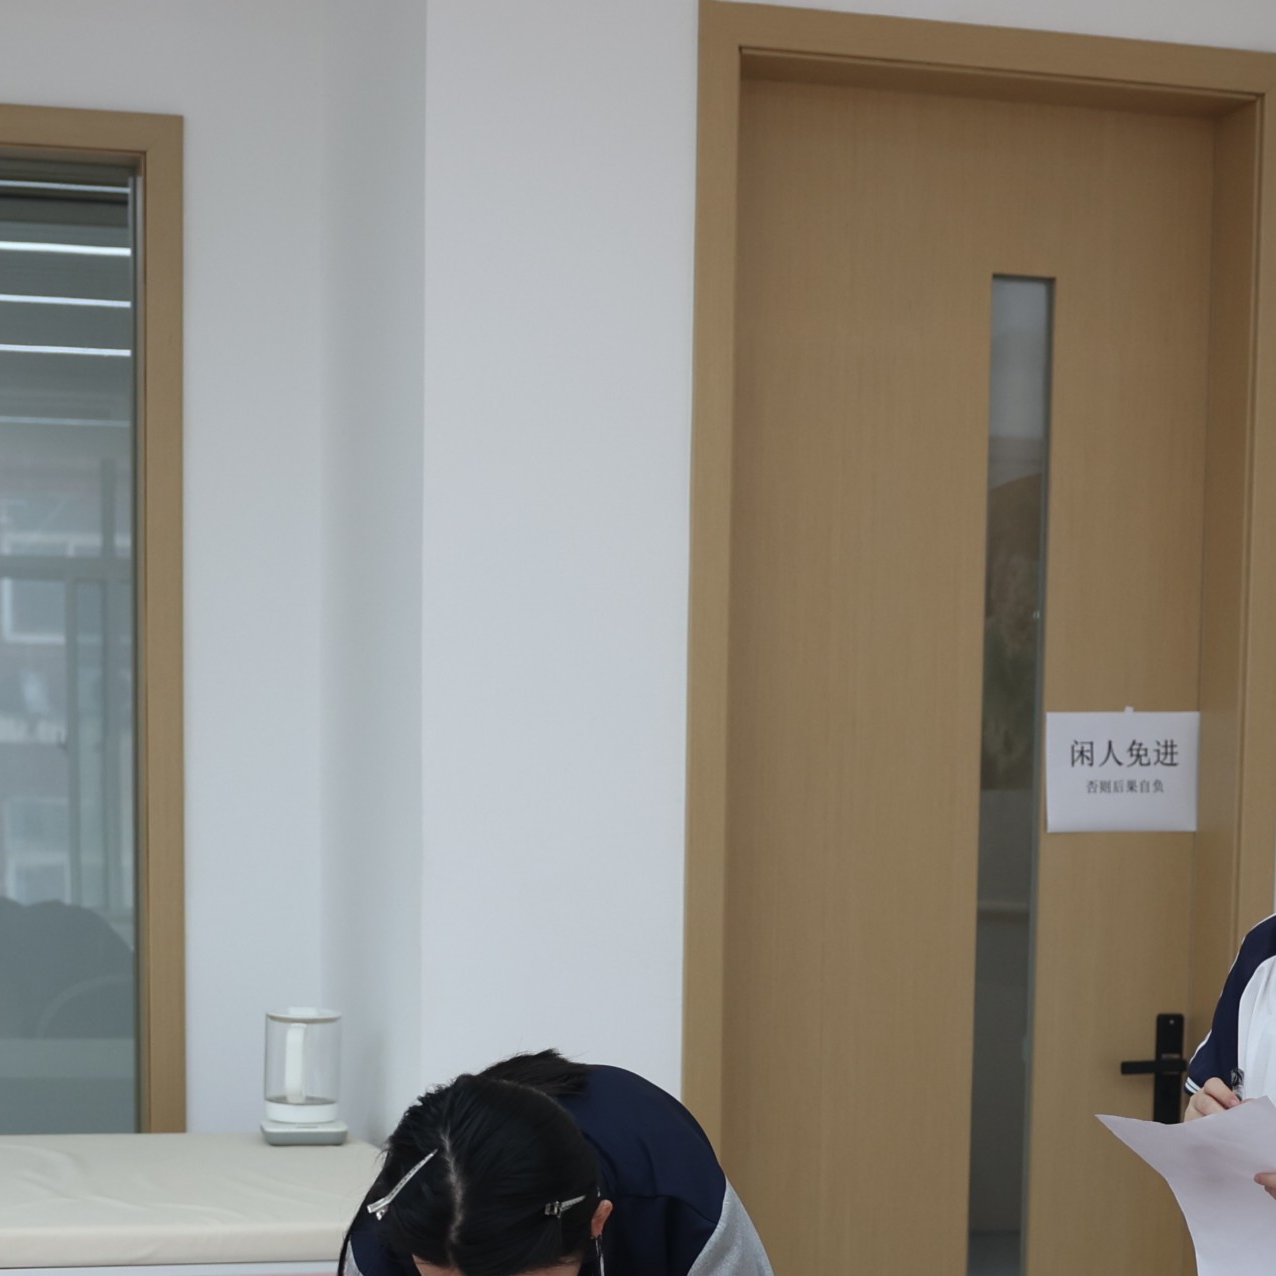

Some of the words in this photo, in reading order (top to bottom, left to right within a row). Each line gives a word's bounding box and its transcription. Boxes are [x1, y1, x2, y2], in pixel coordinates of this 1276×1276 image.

[1070, 739, 1179, 768] 闲人免进
[1086, 779, 1165, 794] 否则后果自负
